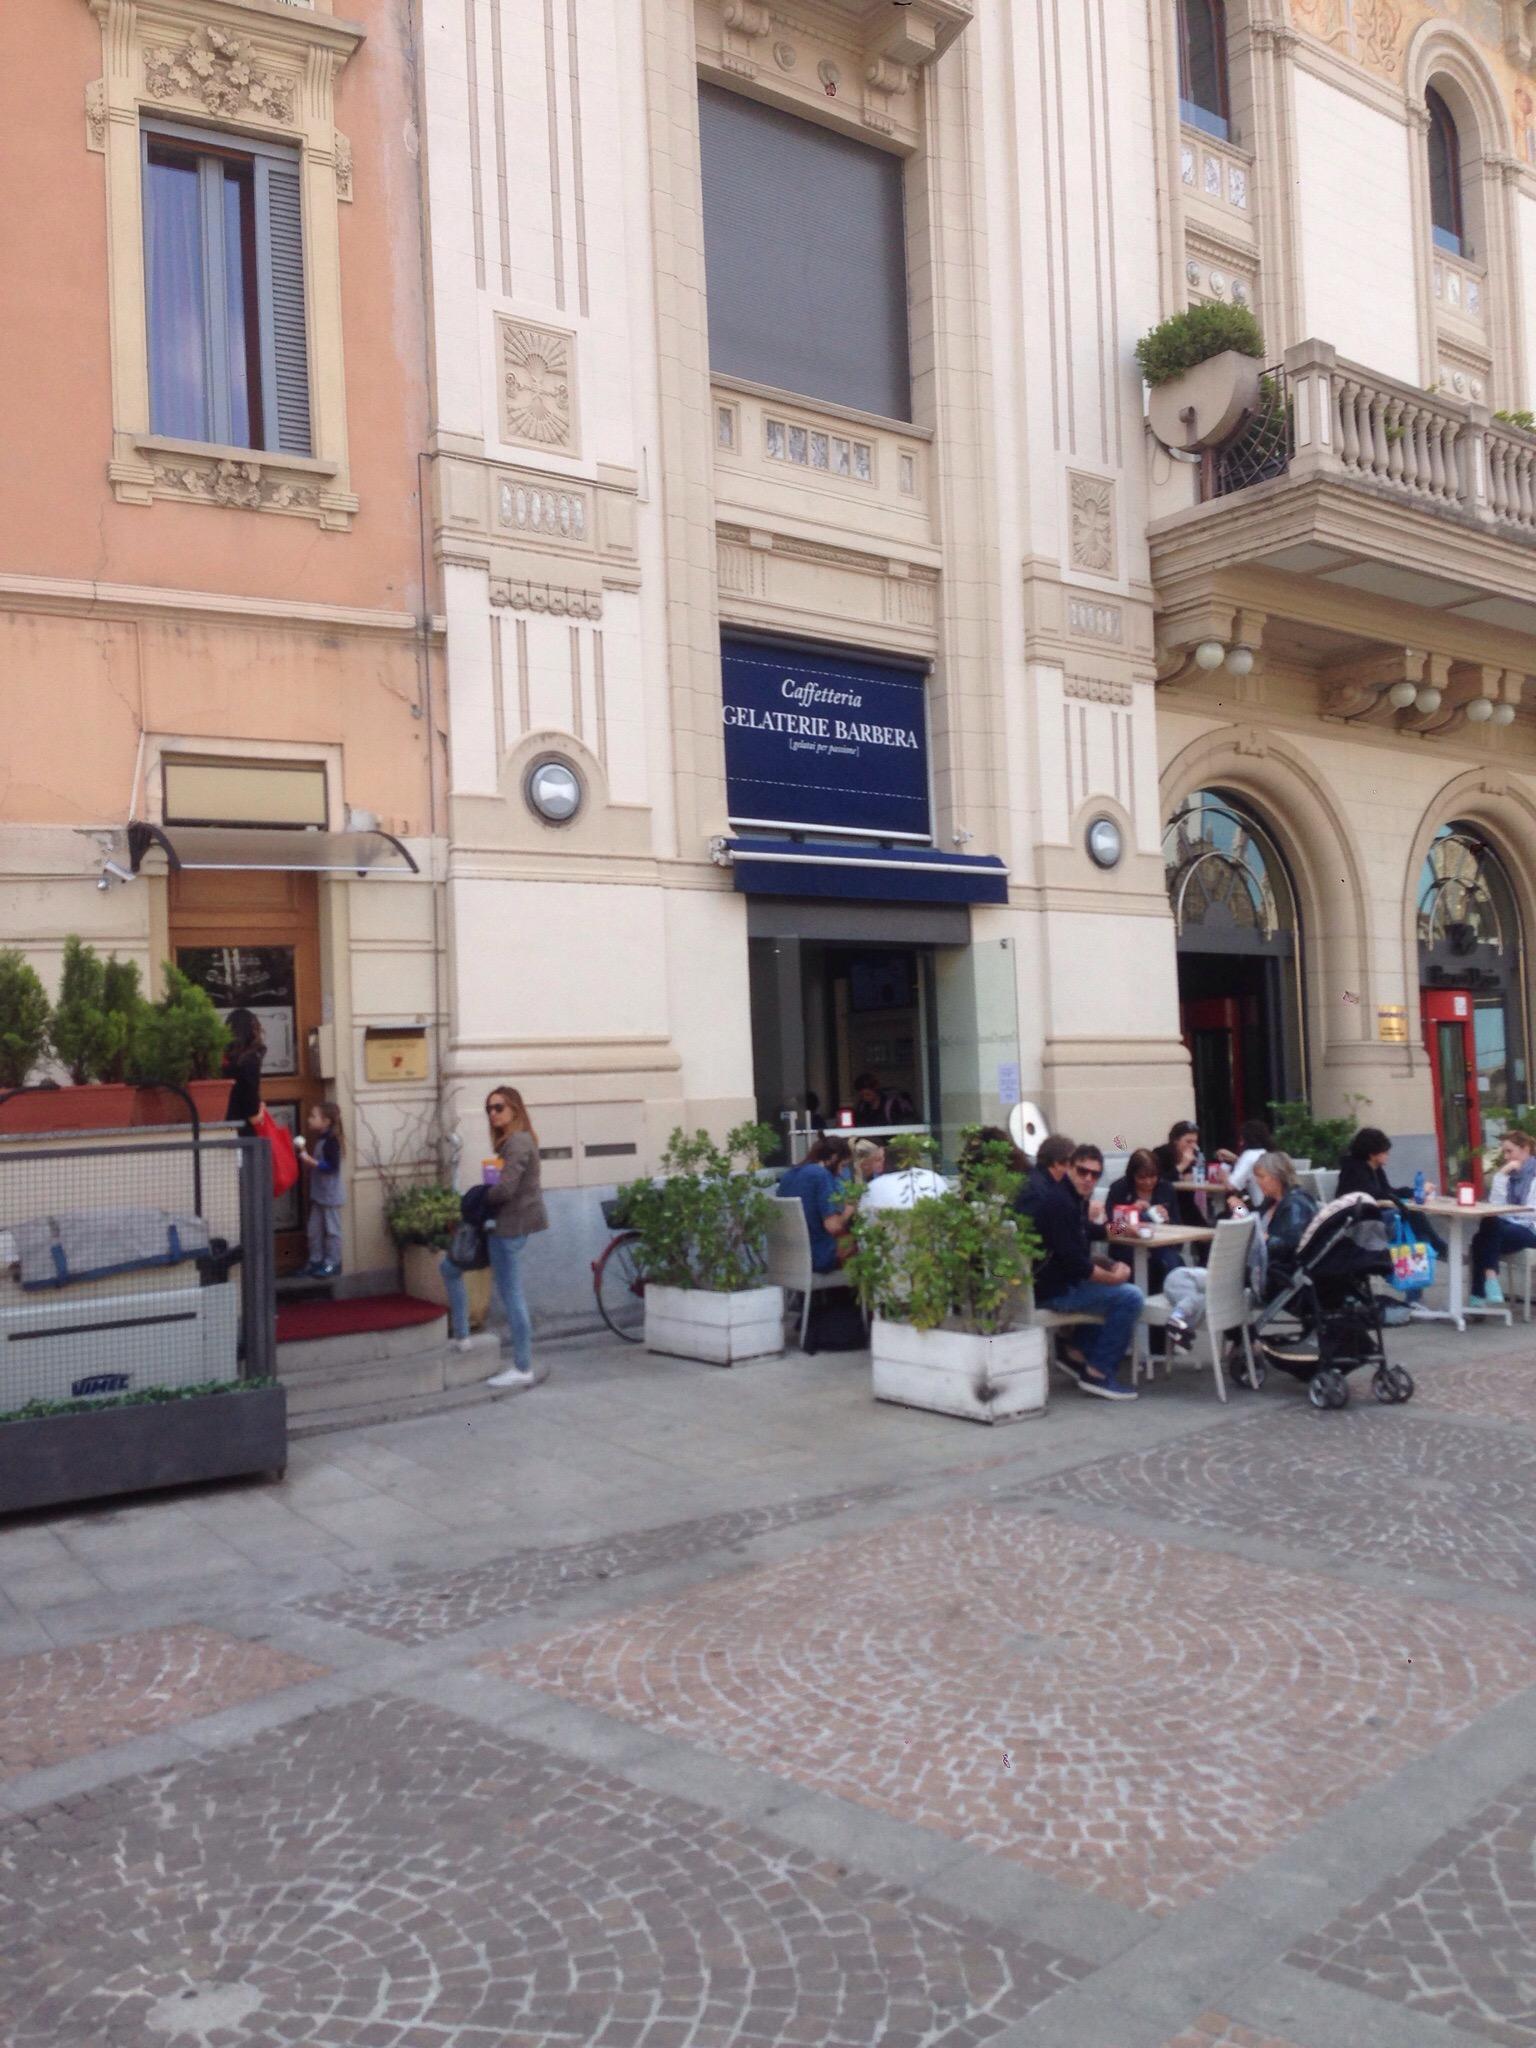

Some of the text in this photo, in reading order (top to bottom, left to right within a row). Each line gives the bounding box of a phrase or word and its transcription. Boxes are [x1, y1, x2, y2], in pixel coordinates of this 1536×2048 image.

[781, 678, 862, 707] Caffetteria
[722, 705, 919, 749] GELATERIE BARBERA
